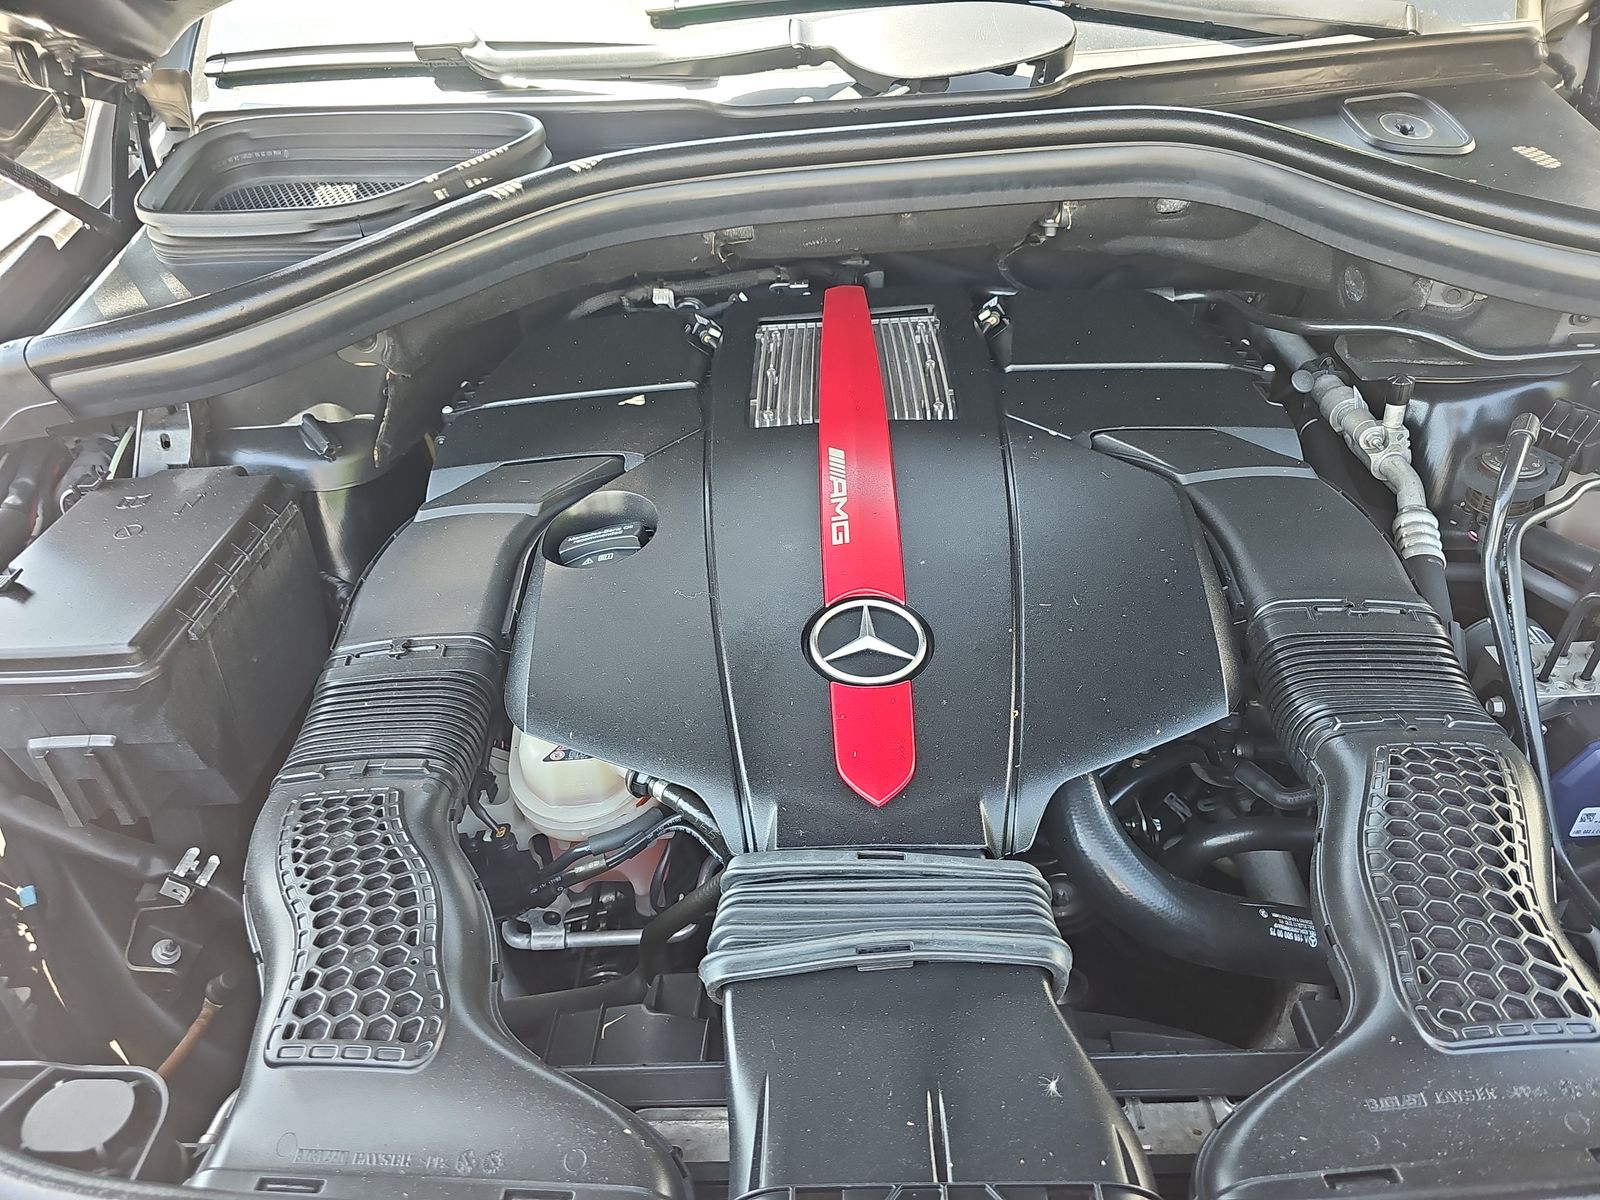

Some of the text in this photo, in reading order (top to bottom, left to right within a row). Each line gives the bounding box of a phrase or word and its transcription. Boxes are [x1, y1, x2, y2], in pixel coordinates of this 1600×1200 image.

[829, 474, 850, 546] AMG
[568, 527, 622, 542] Mercedes-Benz
[573, 530, 624, 544] recommended
